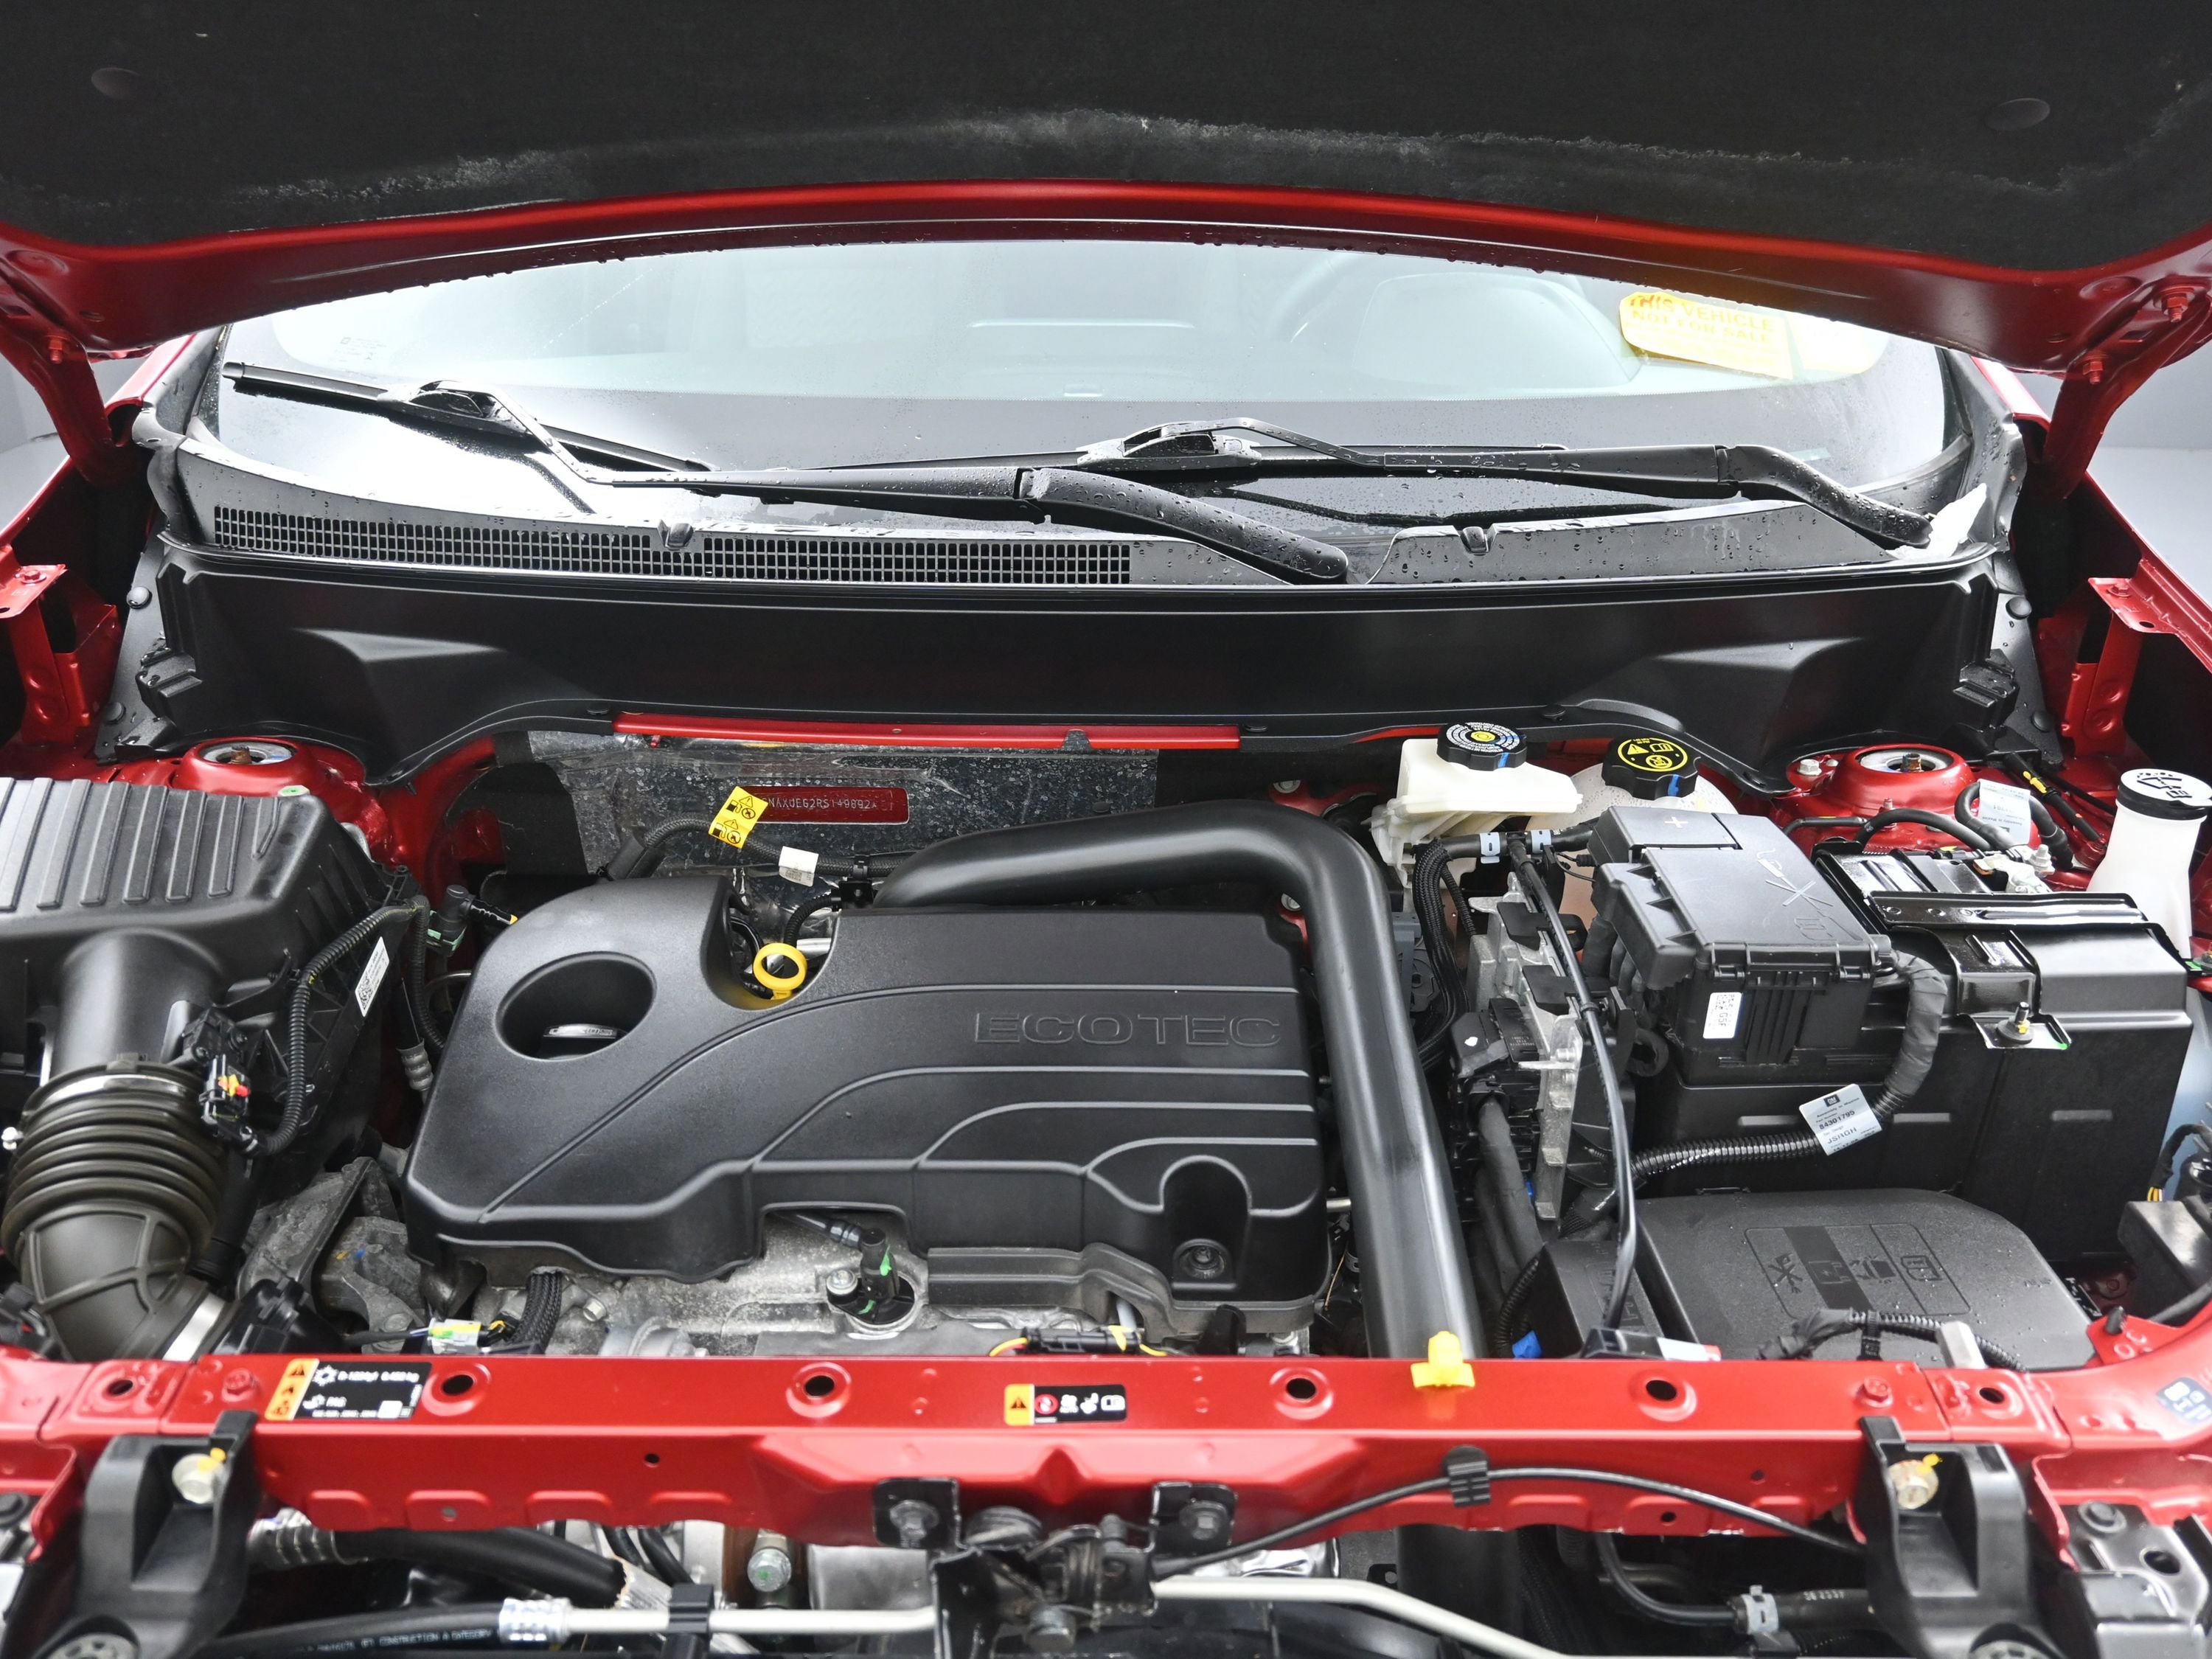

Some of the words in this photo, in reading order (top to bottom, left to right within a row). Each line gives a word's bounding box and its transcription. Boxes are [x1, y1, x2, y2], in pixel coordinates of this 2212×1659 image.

[1630, 294, 1674, 313] THIS
[1680, 301, 1774, 331] VEHICLE
[1631, 309, 1669, 325] NOT
[1677, 318, 1715, 334] FOR
[1722, 326, 1770, 343] SALE
[975, 1012, 1281, 1047] ECOTEC
[1819, 1110, 1855, 1130] 84301795
